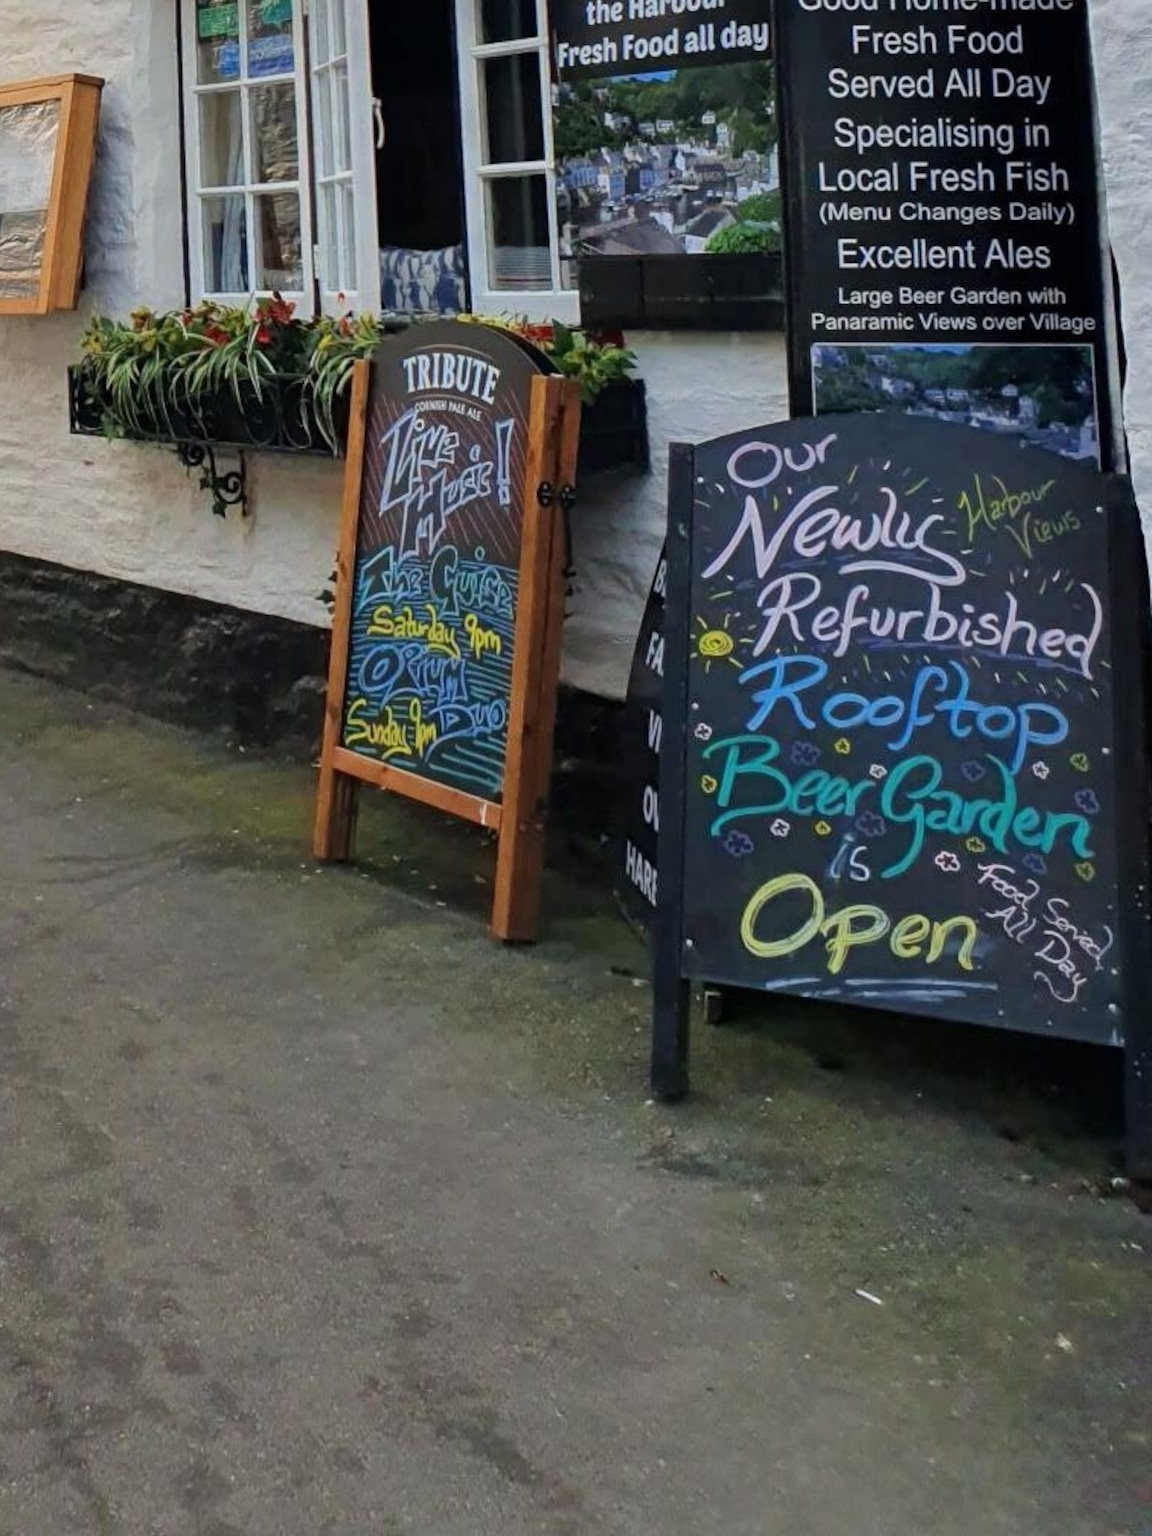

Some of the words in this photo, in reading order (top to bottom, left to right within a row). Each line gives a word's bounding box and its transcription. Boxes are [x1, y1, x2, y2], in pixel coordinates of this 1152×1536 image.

[559, 37, 617, 67] Fresh
[623, 28, 679, 60] Food
[684, 23, 715, 53] all
[721, 20, 770, 51] day
[852, 25, 937, 54] Fresh
[948, 25, 1023, 54] Food
[828, 68, 934, 98] Served
[944, 68, 981, 98] All
[993, 68, 1051, 105] Day
[834, 117, 1014, 154] Specialising
[1025, 118, 1050, 147] in
[818, 162, 898, 192] Local
[910, 162, 995, 192] Fresh
[1006, 162, 1069, 192] Fish
[819, 203, 891, 225] (Menu
[899, 202, 1002, 225] Changes
[1009, 202, 1075, 225] Daily)
[837, 238, 976, 269] Excellent
[985, 238, 1051, 269] Ales
[838, 286, 893, 309] Large
[899, 286, 944, 305] Beer
[950, 286, 1022, 305] Garden
[1027, 286, 1066, 305] with
[811, 312, 914, 331] Panaramic
[919, 312, 977, 331] Views
[982, 317, 1025, 331] over
[1029, 312, 1096, 335] Village
[403, 352, 501, 405] TRIBUTE
[414, 399, 448, 413] CORNISH
[448, 400, 466, 416] PALE
[467, 407, 483, 422] ALE
[727, 432, 838, 489] Our
[957, 472, 1056, 542] Harbour
[701, 485, 966, 586] Newly
[1004, 511, 1081, 559] Views
[366, 604, 461, 660] Saturday
[464, 613, 502, 659] 9pm
[751, 571, 1103, 679] Refurbished
[345, 698, 412, 759] Sunday
[410, 697, 437, 758] 9pm
[738, 653, 1070, 775] Rooftop
[702, 734, 876, 837] Beer
[880, 753, 1095, 880] Garden
[830, 833, 871, 883] is
[977, 863, 1040, 912] Food
[740, 873, 979, 975] Open
[984, 905, 1036, 944] All
[1034, 930, 1088, 1004] Day
